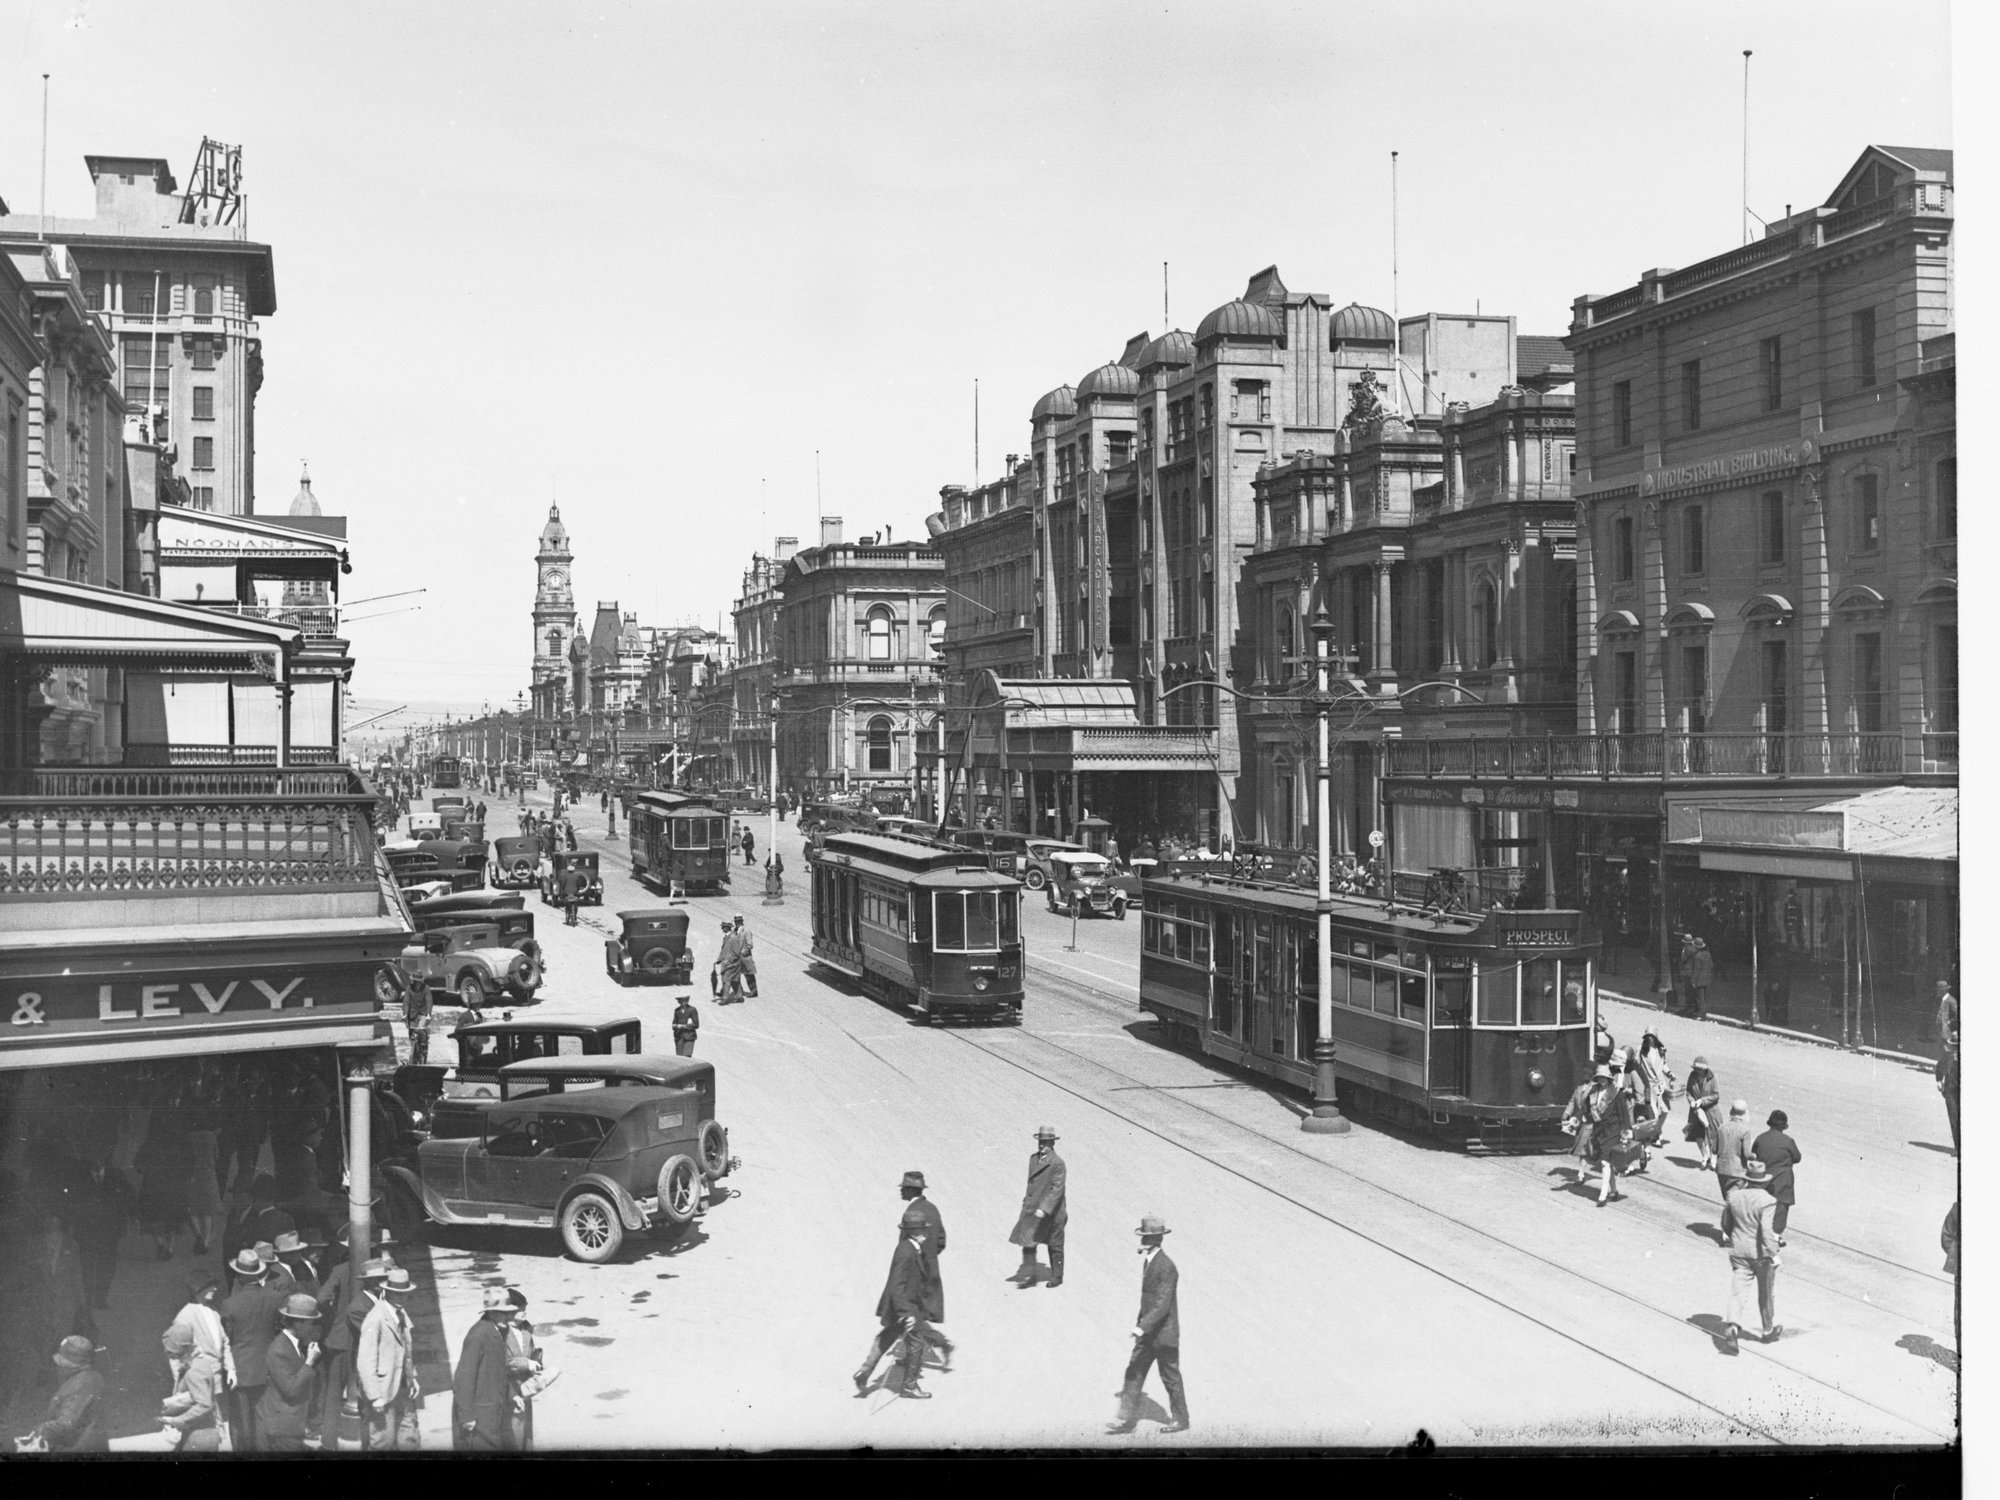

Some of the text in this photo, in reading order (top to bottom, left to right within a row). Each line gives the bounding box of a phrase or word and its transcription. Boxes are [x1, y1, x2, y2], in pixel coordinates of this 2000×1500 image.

[1657, 459, 1728, 489] INDUSTRIAL
[175, 538, 295, 549] NOONAN'S
[1094, 525, 1102, 599] ARCADIA
[996, 857, 1010, 868] 16
[1507, 930, 1568, 941] PROSPECT
[998, 966, 1017, 979] 127
[11, 977, 313, 1024] & LEVY.
